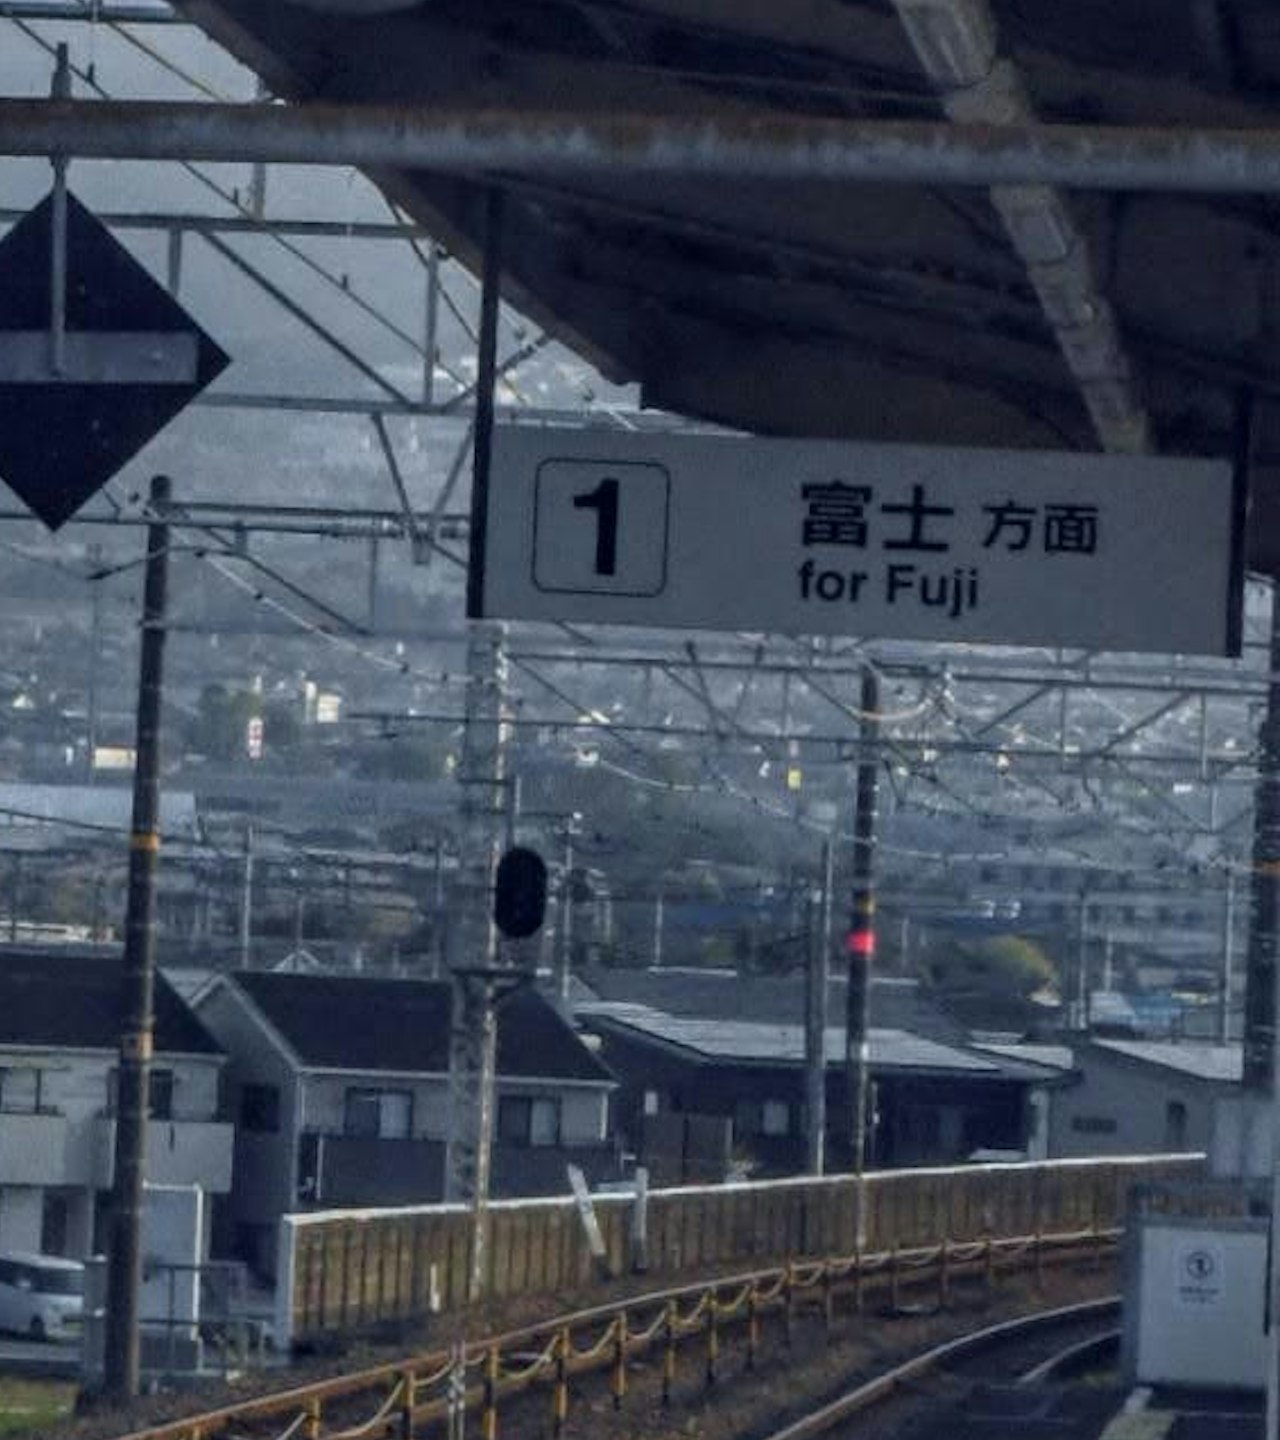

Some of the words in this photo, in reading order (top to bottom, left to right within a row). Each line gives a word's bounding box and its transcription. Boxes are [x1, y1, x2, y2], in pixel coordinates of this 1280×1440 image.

[573, 478, 621, 577] 1
[797, 559, 869, 603] for
[886, 564, 979, 619] Fuji
